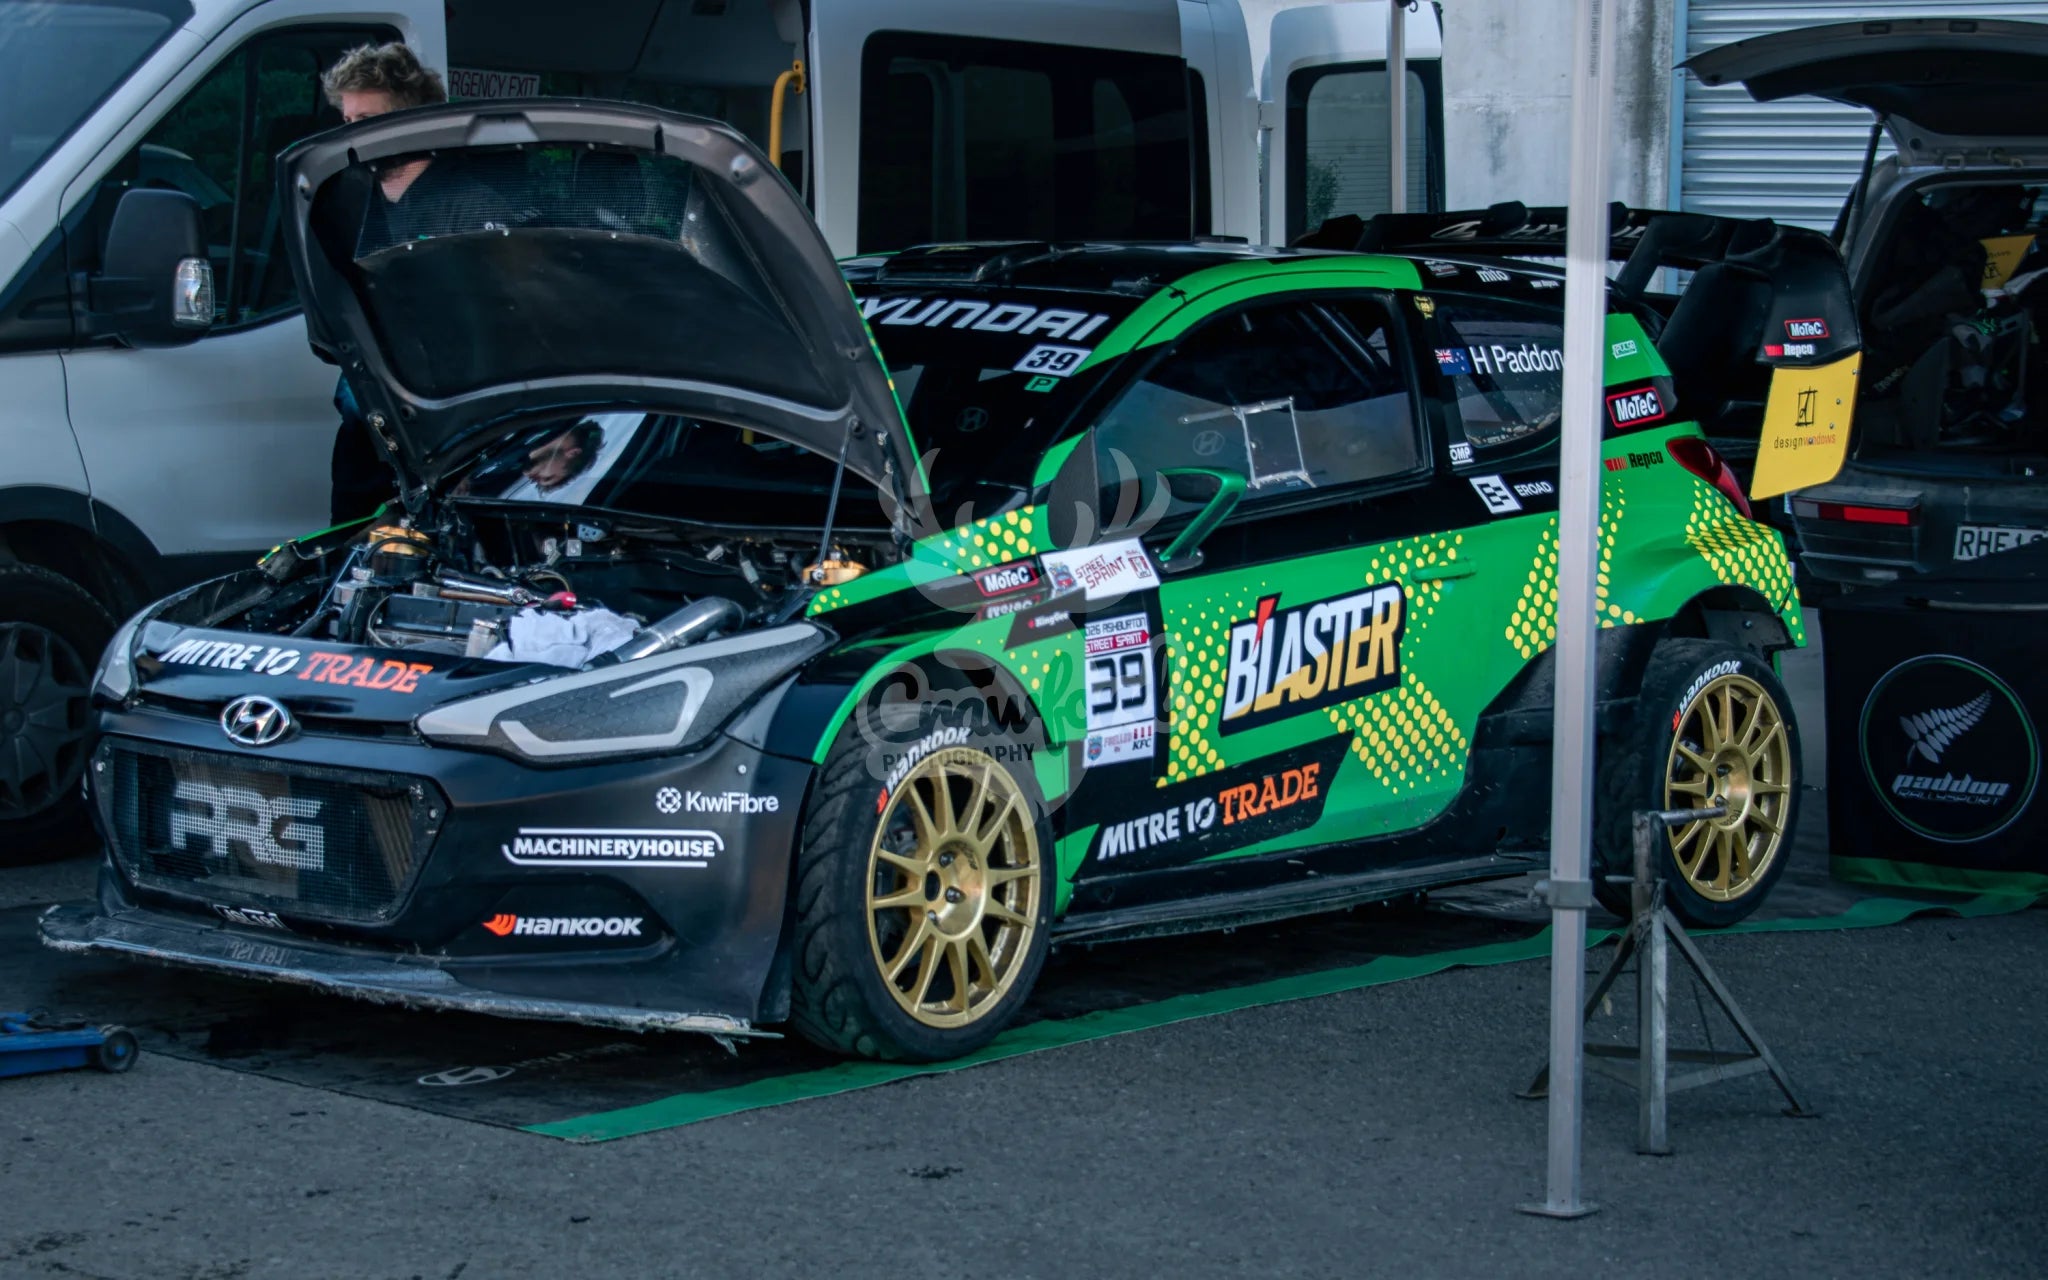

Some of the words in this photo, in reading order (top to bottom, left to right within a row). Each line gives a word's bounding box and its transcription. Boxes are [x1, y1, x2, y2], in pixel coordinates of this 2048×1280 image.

[857, 297, 1109, 341] YUNDAI
[1789, 322, 1824, 337] MoTeC
[1026, 350, 1081, 372] 39
[1469, 346, 1492, 374] H
[1491, 343, 1565, 374] Paddon
[1783, 343, 1814, 358] Repco
[1031, 376, 1053, 390] P
[1615, 391, 1657, 422] MoTeC
[1450, 447, 1471, 461] OMP
[1628, 451, 1664, 470] Repco
[1514, 481, 1553, 497] EROAD
[1075, 554, 1107, 580] STREET
[1085, 556, 1129, 590] SPRINT
[984, 566, 1030, 594] MoTeC
[1086, 637, 1114, 653] STREET
[1222, 585, 1401, 721] BLASTER
[159, 640, 262, 671] MITRE
[254, 647, 300, 676] 10
[297, 652, 433, 694] TRADE
[1090, 652, 1147, 715] 39
[1132, 738, 1152, 751] KFC
[1892, 772, 2010, 796] paddon
[685, 791, 779, 813] KiwiFibre
[1097, 807, 1181, 860] MITRE
[1184, 797, 1216, 833] 10
[1219, 762, 1321, 826] TRADE
